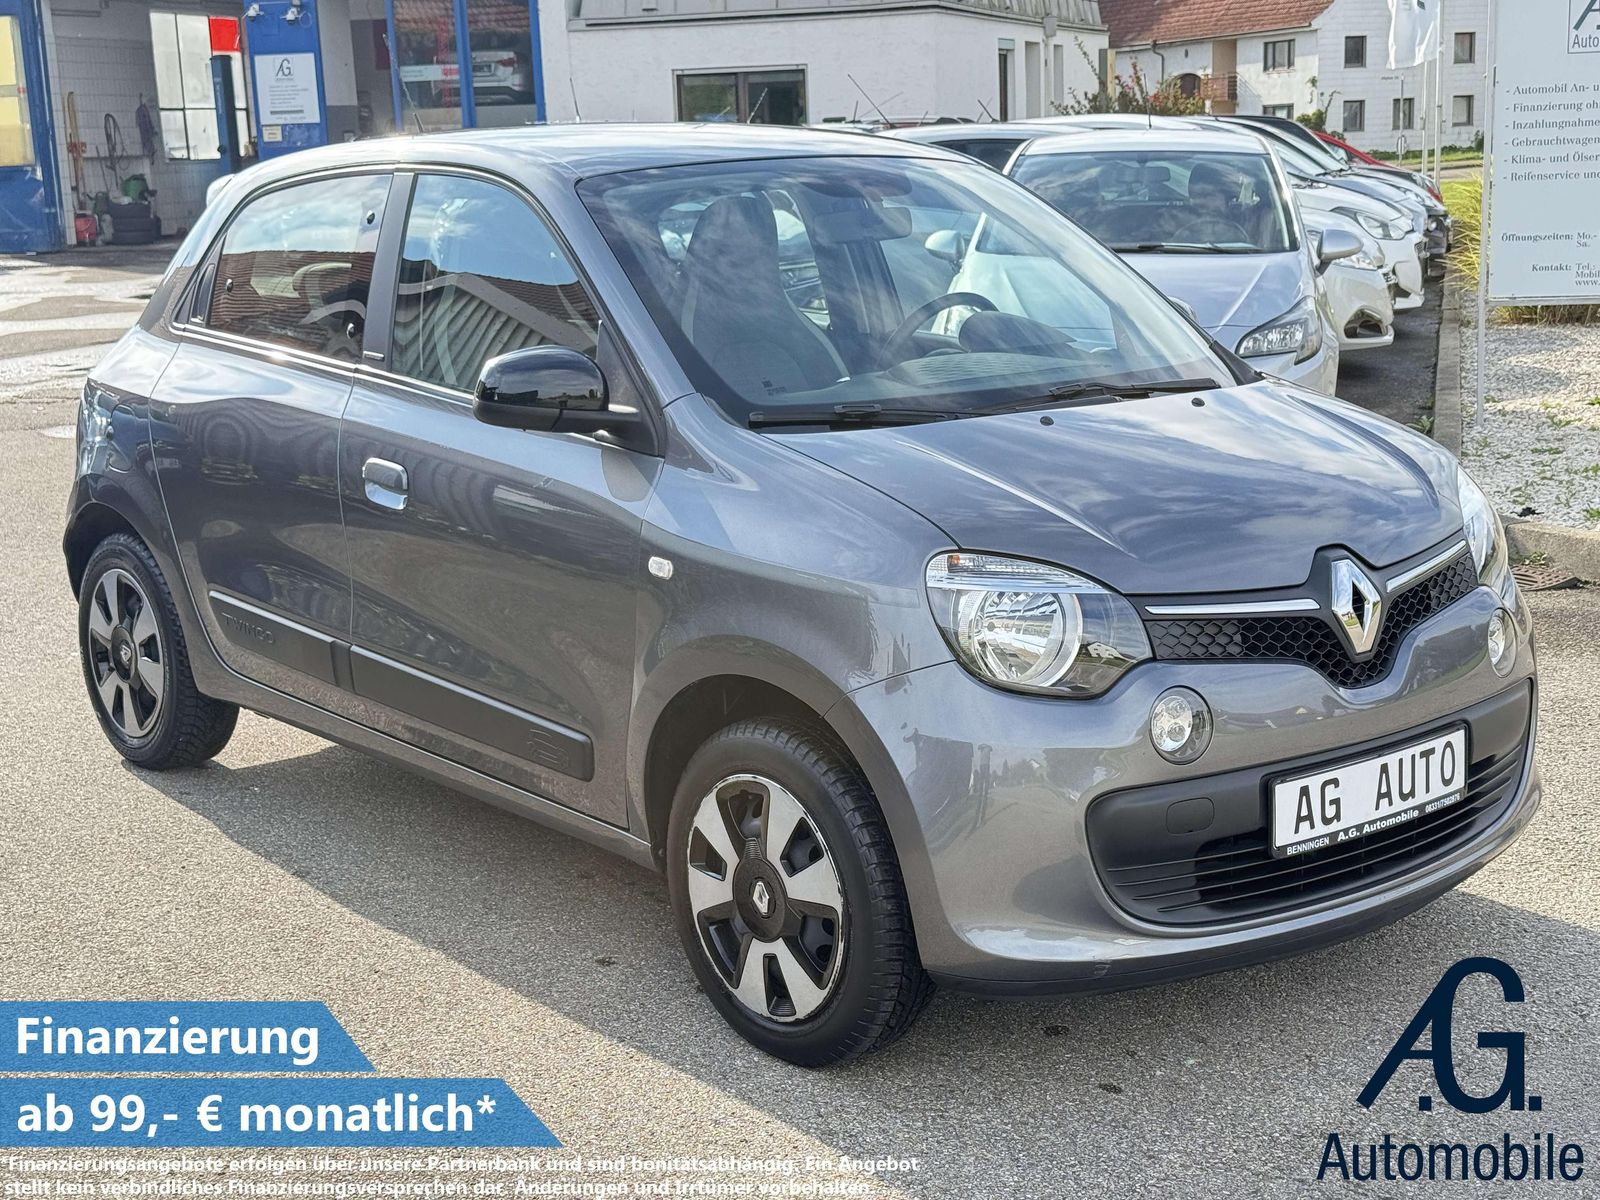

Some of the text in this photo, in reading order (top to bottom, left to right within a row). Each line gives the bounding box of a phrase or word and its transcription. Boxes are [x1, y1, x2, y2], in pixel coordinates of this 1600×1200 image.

[1513, 83, 1568, 95] Automobil
[1570, 83, 1590, 93] An-
[1513, 101, 1583, 113] Finanzierung
[1586, 100, 1600, 110] oh
[1512, 118, 1600, 131] Inzahlungnahme
[1511, 154, 1546, 165] Klima-
[1549, 153, 1569, 163] und
[1510, 171, 1580, 182] Reifenservice
[1501, 232, 1574, 243] Öffnungszeiten:
[1531, 263, 1572, 272] Kontakt:
[221, 611, 275, 645] TWINGO
[1294, 740, 1456, 835] AG AUTO
[1286, 836, 1330, 856] BENNINGEN
[1337, 828, 1360, 842] A.G.
[1362, 809, 1419, 834] Automobile
